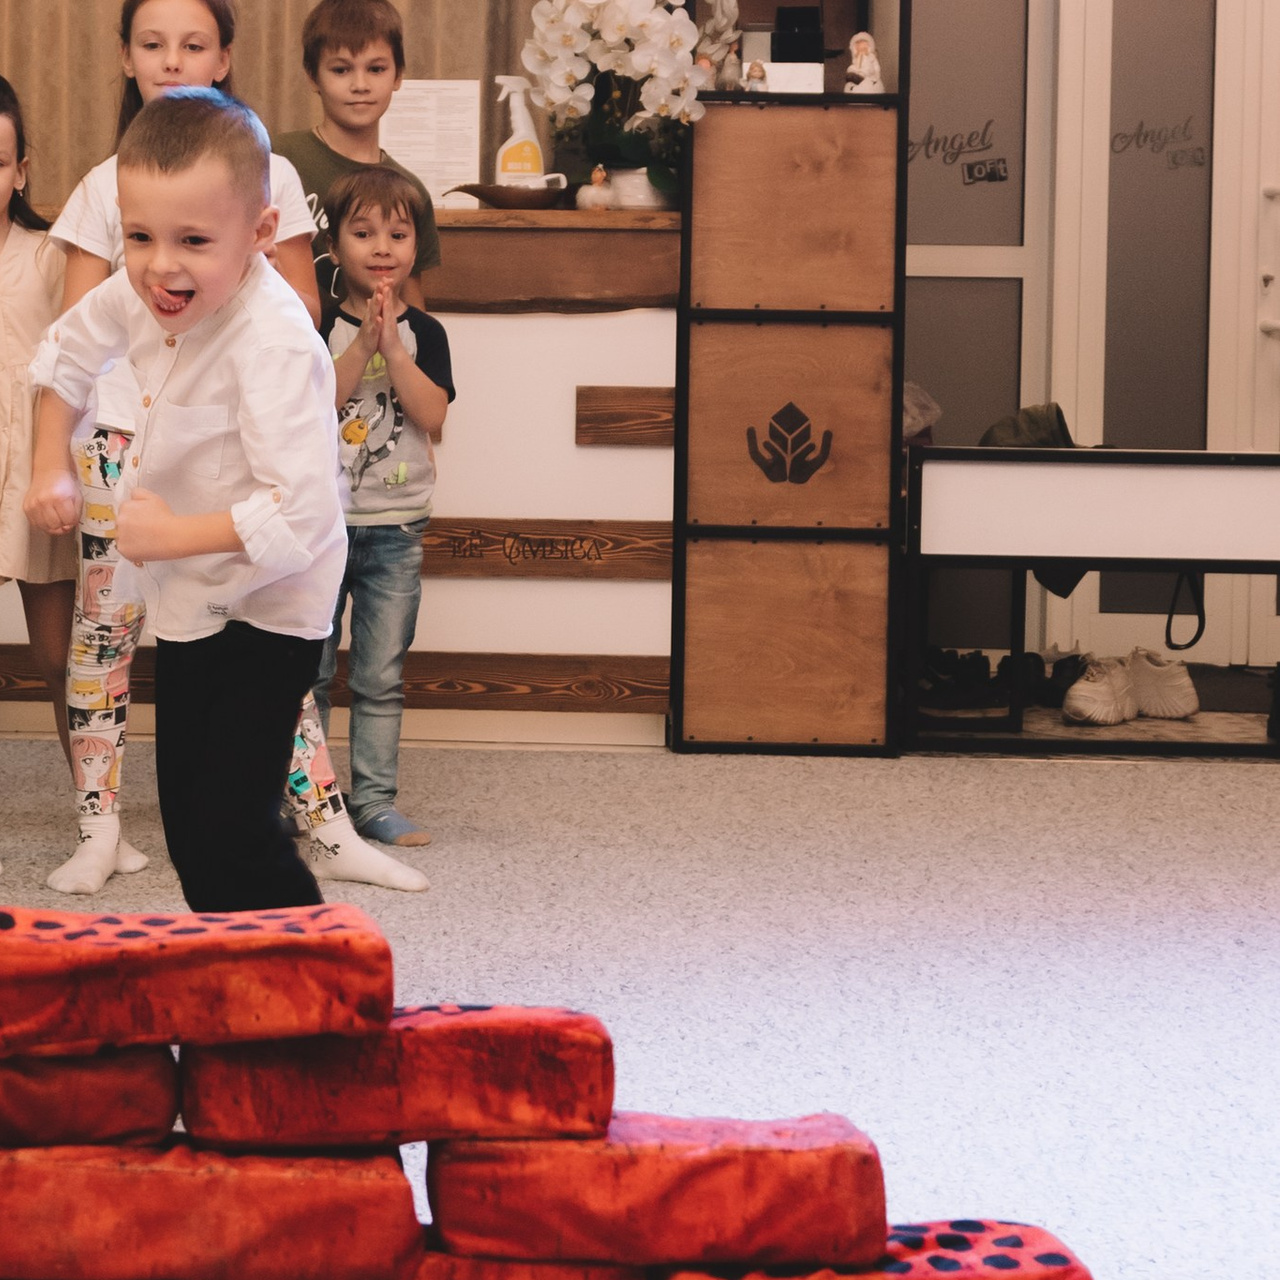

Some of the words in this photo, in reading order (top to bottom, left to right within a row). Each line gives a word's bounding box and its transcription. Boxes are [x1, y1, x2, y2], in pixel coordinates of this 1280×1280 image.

[907, 119, 994, 165] Angel
[1111, 116, 1193, 154] Angel
[85, 440, 107, 455] やあ
